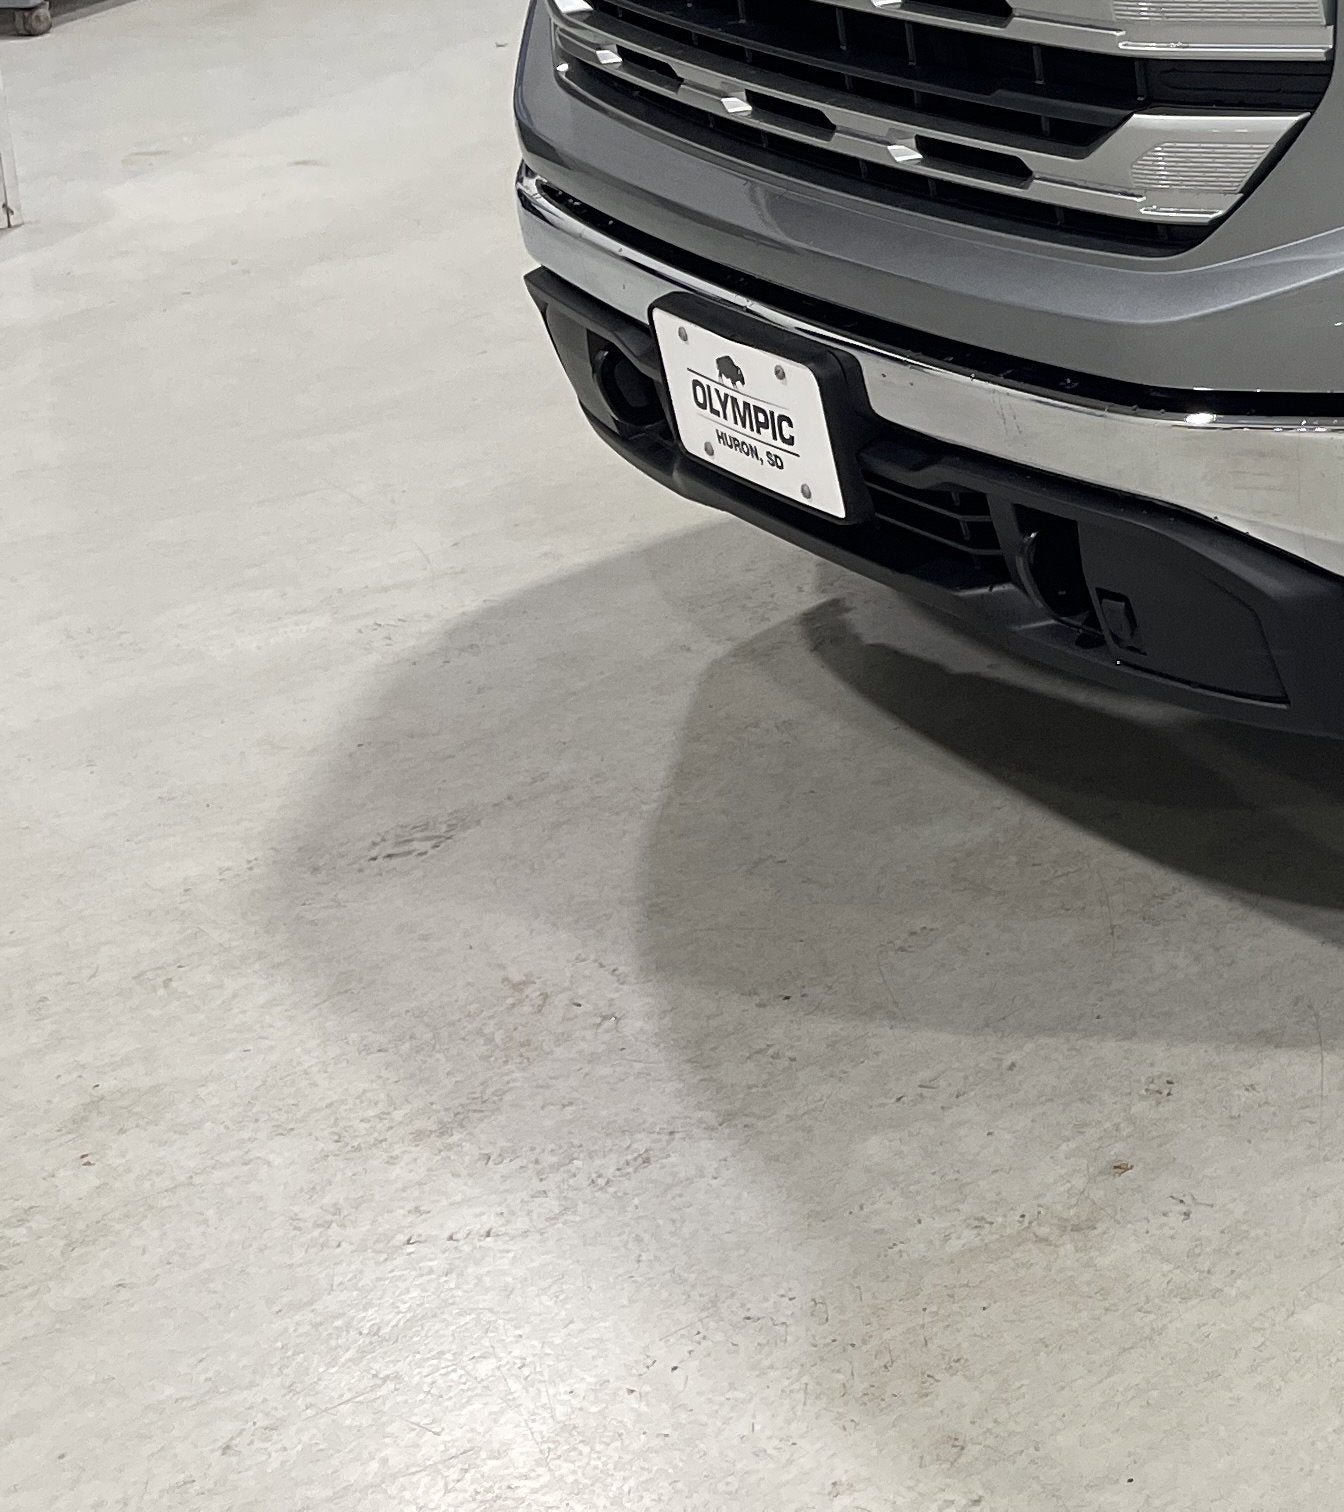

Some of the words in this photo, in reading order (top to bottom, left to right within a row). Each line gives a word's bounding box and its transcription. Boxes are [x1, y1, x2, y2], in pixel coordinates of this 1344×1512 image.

[691, 378, 796, 447] OLYMPIC
[716, 428, 764, 466] HURON,
[766, 449, 785, 471] SD
